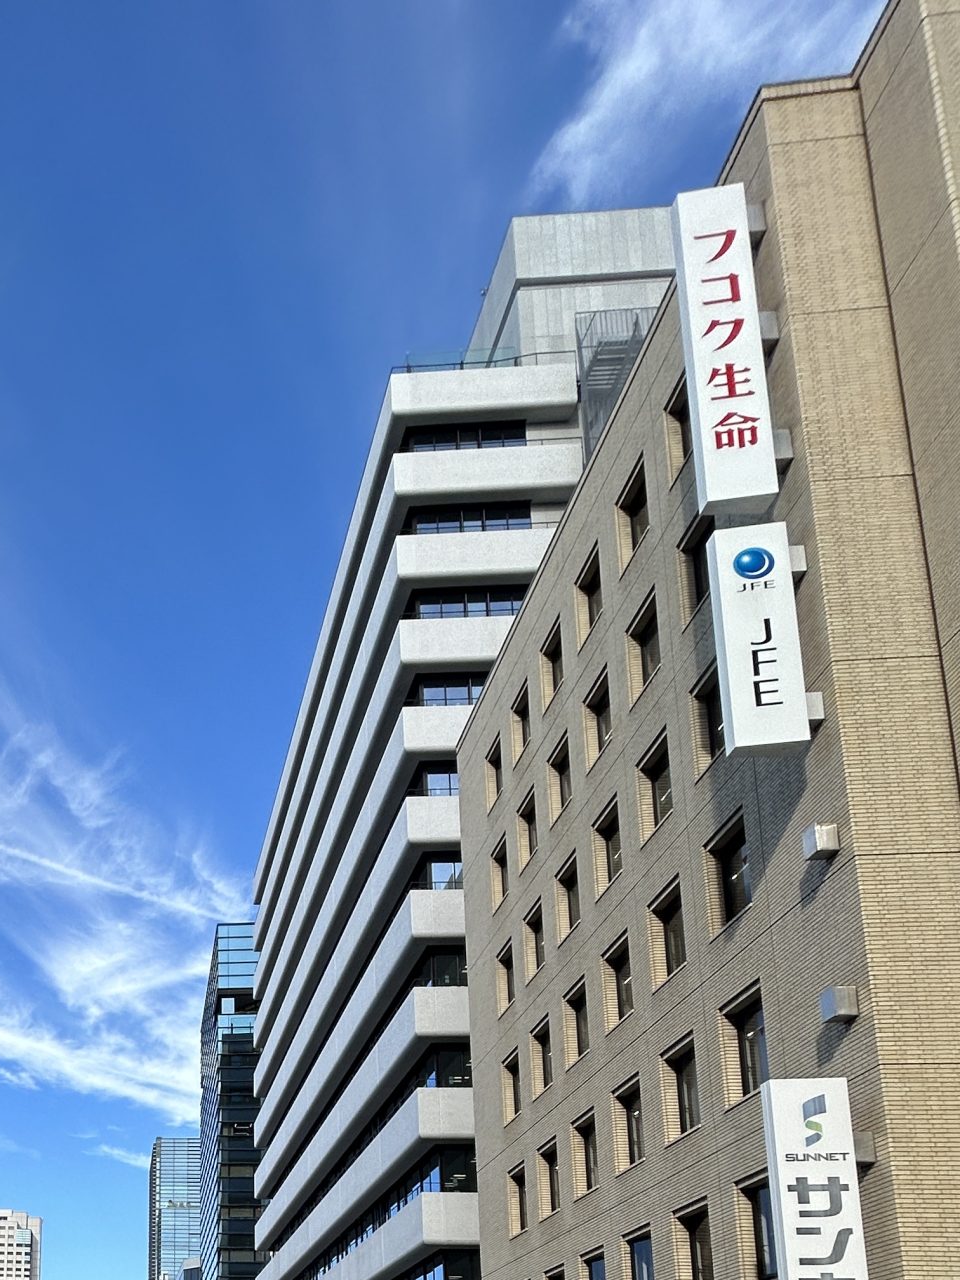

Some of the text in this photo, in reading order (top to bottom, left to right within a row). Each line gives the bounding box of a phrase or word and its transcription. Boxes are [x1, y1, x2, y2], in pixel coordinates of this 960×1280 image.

[693, 228, 761, 450] フコク生命
[736, 579, 776, 593] JFE
[750, 617, 784, 708] JFE
[784, 1152, 851, 1163] SUNNET
